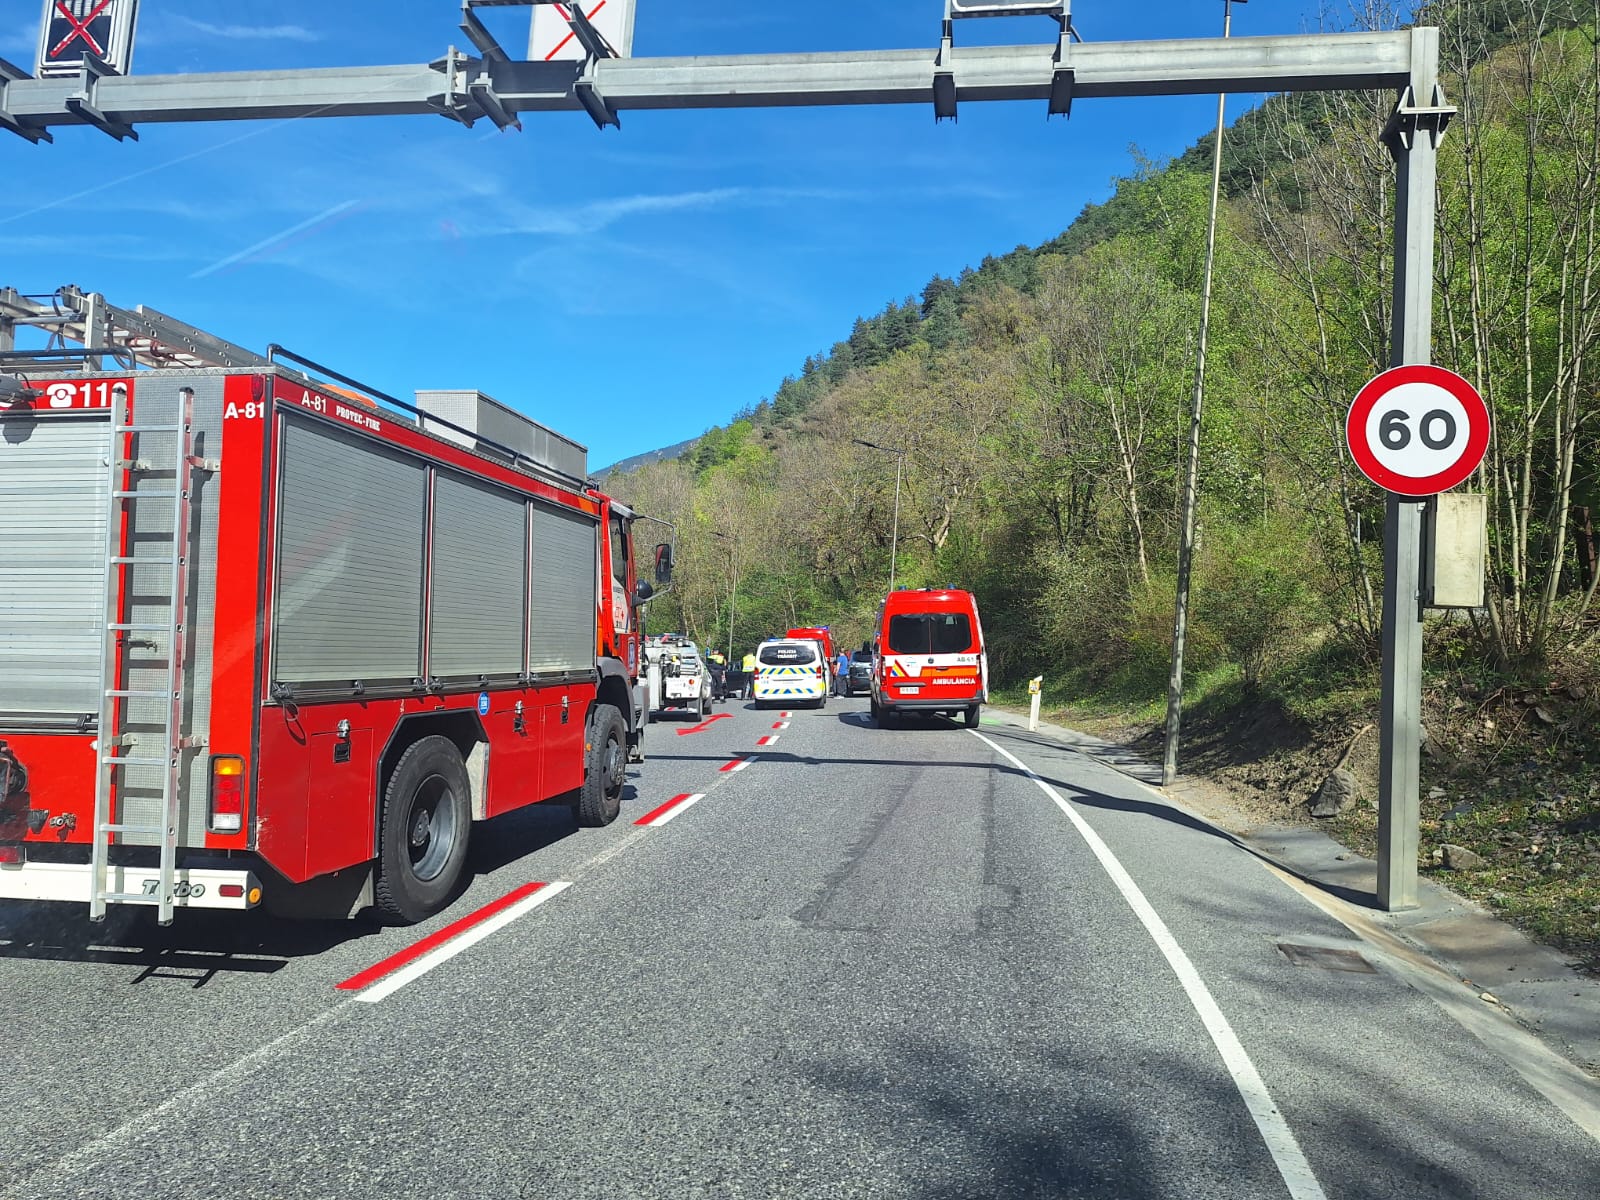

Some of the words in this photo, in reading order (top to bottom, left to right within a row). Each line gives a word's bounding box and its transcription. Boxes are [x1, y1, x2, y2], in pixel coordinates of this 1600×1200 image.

[224, 402, 265, 419] A-81
[301, 390, 327, 414] A-81
[335, 405, 381, 431] PROTEC-FIRE
[1379, 409, 1457, 451] 60
[142, 879, 206, 898] Trbo
